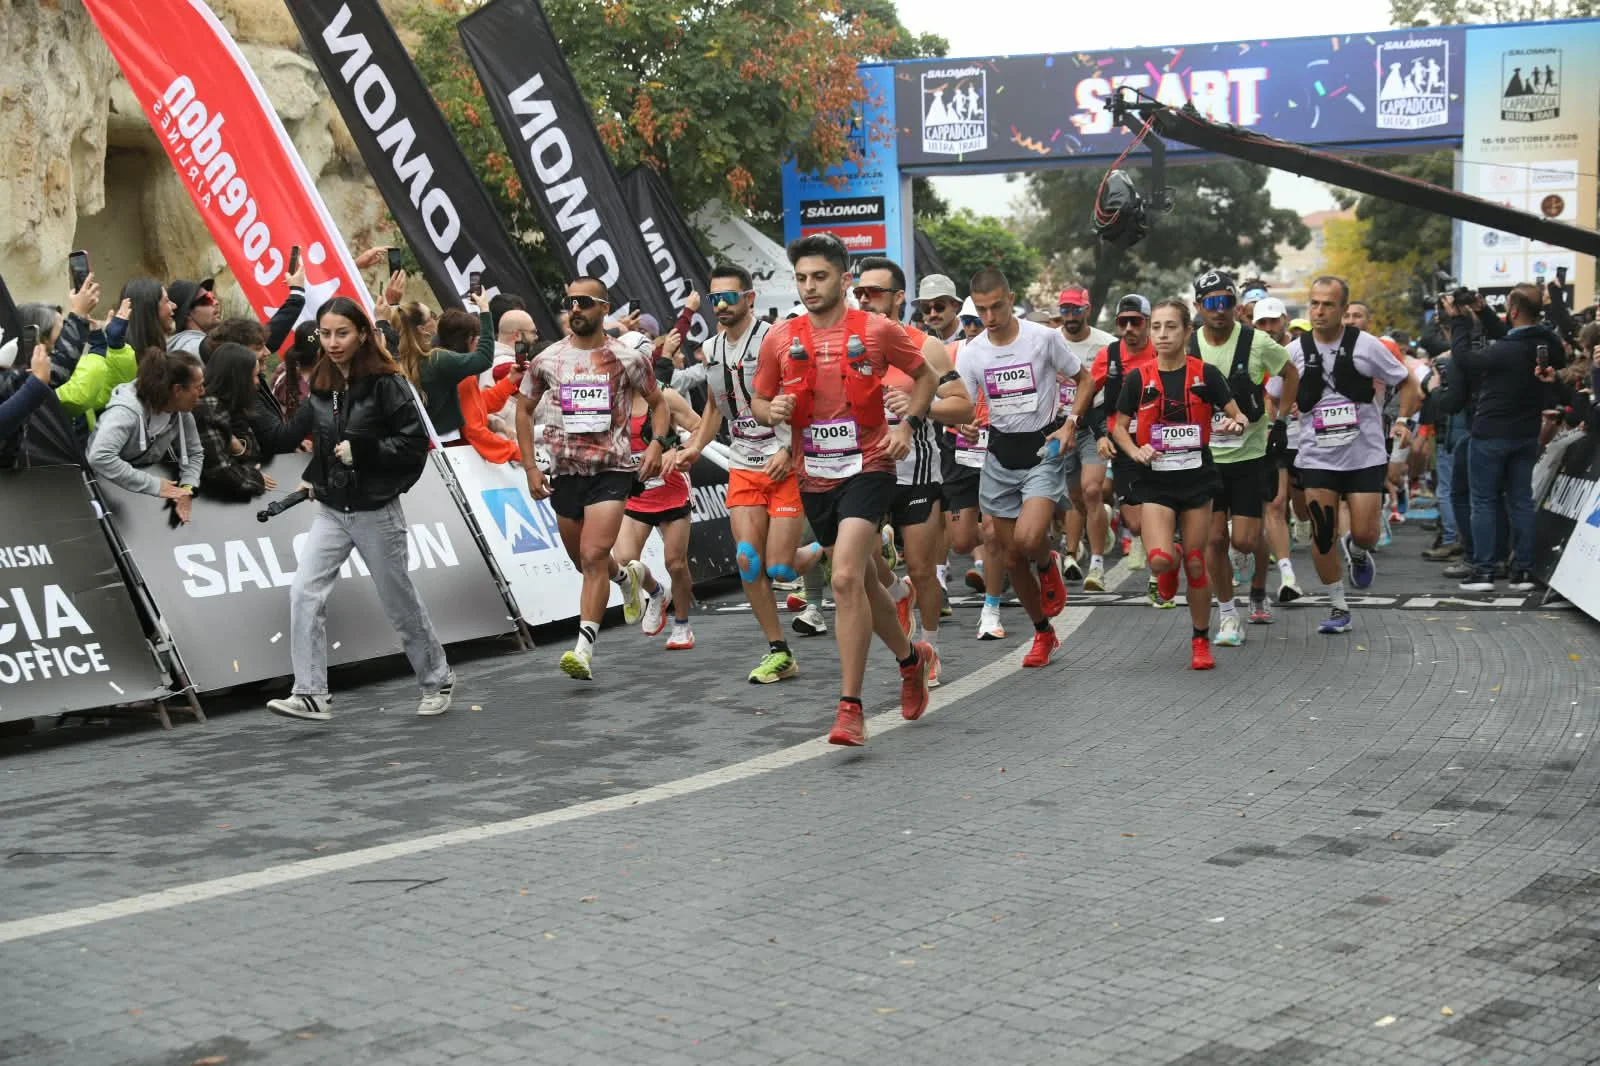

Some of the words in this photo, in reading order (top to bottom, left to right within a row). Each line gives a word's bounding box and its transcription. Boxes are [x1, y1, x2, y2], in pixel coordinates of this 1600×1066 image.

[1069, 67, 1269, 134] START
[1381, 98, 1443, 115] CAPPADOCIA
[926, 124, 983, 140] CAPPADOCIA
[807, 203, 878, 218] SALOMON
[995, 369, 1026, 382] 7002
[572, 388, 602, 399] 7047
[1323, 407, 1349, 418] 7971
[811, 425, 848, 439] 7008
[1162, 427, 1194, 439] 7006
[174, 522, 460, 598] SALN
[0, 642, 111, 684] OFFICE
